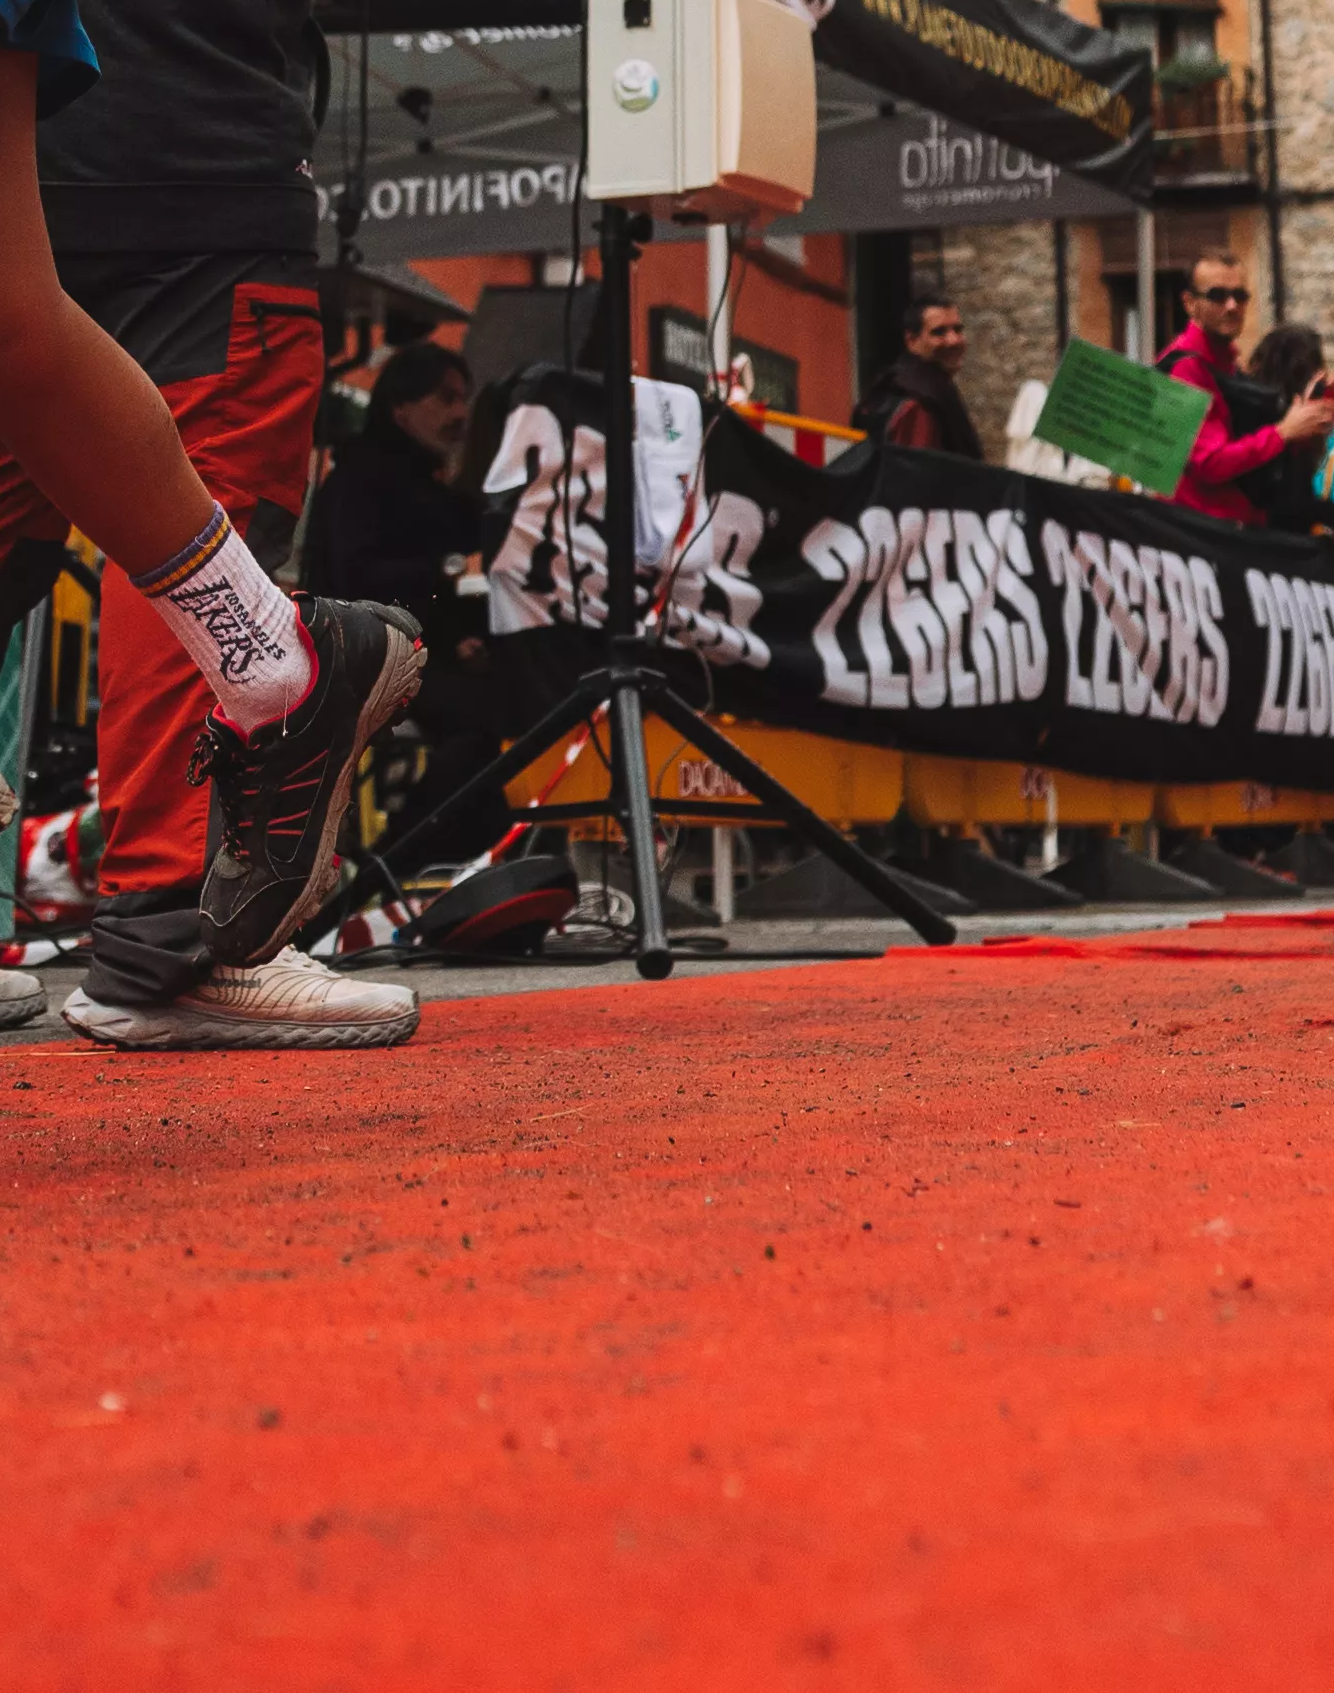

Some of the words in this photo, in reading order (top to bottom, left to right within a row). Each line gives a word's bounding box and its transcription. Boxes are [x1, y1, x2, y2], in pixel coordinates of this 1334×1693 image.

[167, 575, 265, 684] LAKERS
[801, 506, 1049, 709] 226ERS
[1040, 518, 1229, 728] 226ERS
